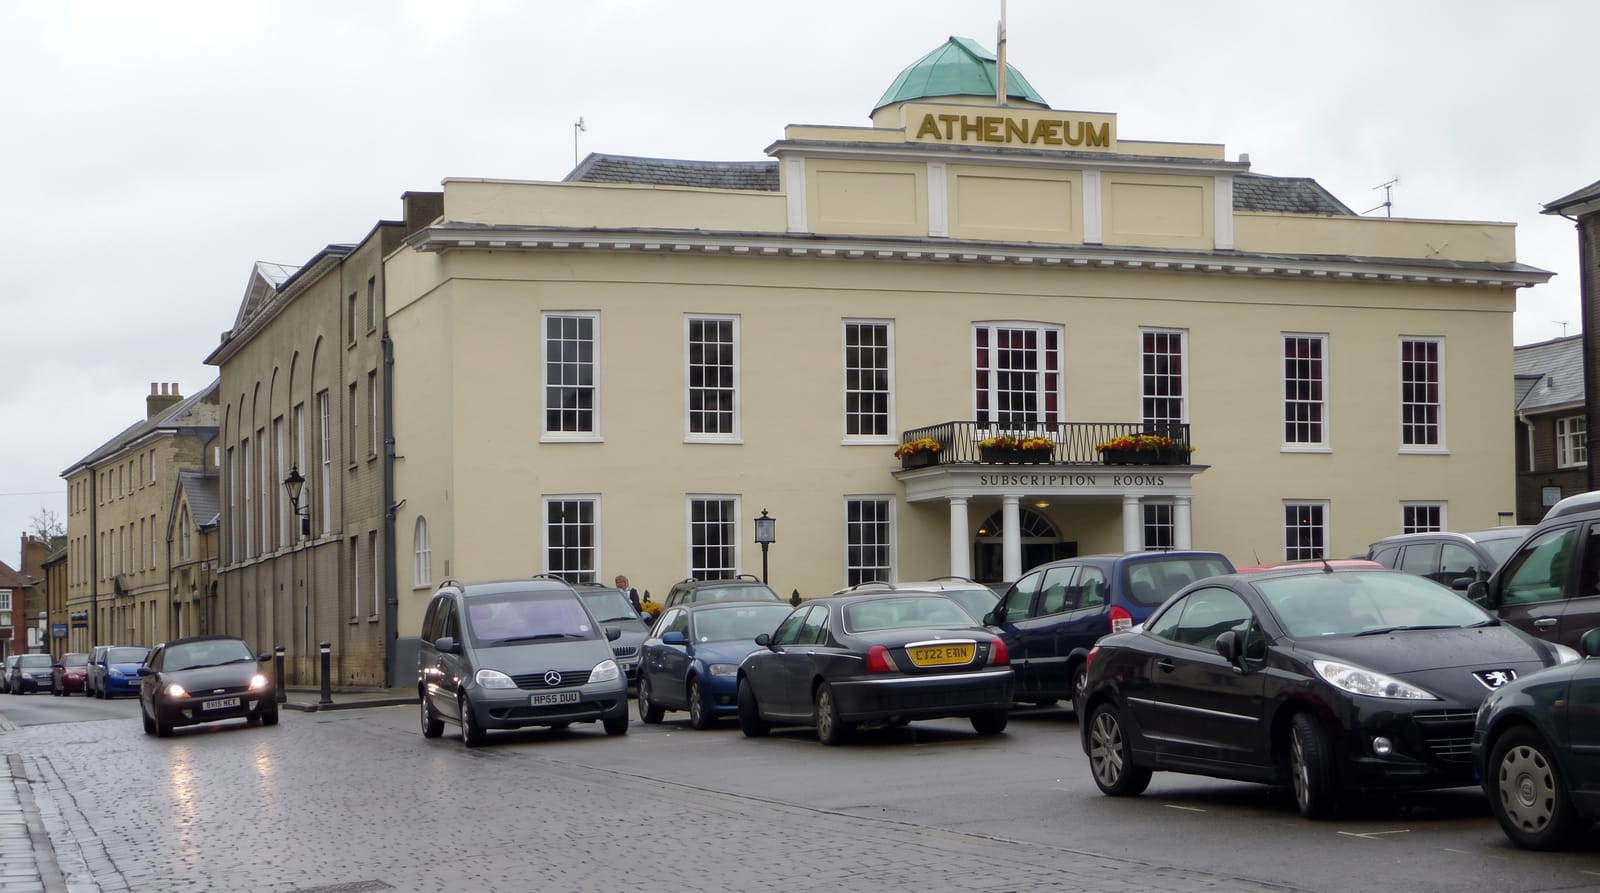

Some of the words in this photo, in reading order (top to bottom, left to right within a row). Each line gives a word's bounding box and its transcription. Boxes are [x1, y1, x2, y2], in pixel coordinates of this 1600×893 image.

[916, 113, 1110, 148] ATHENÆUM
[980, 474, 1097, 486] SUBSCRIPTION
[1112, 474, 1165, 486] ROOMS
[559, 693, 577, 703] DUU
